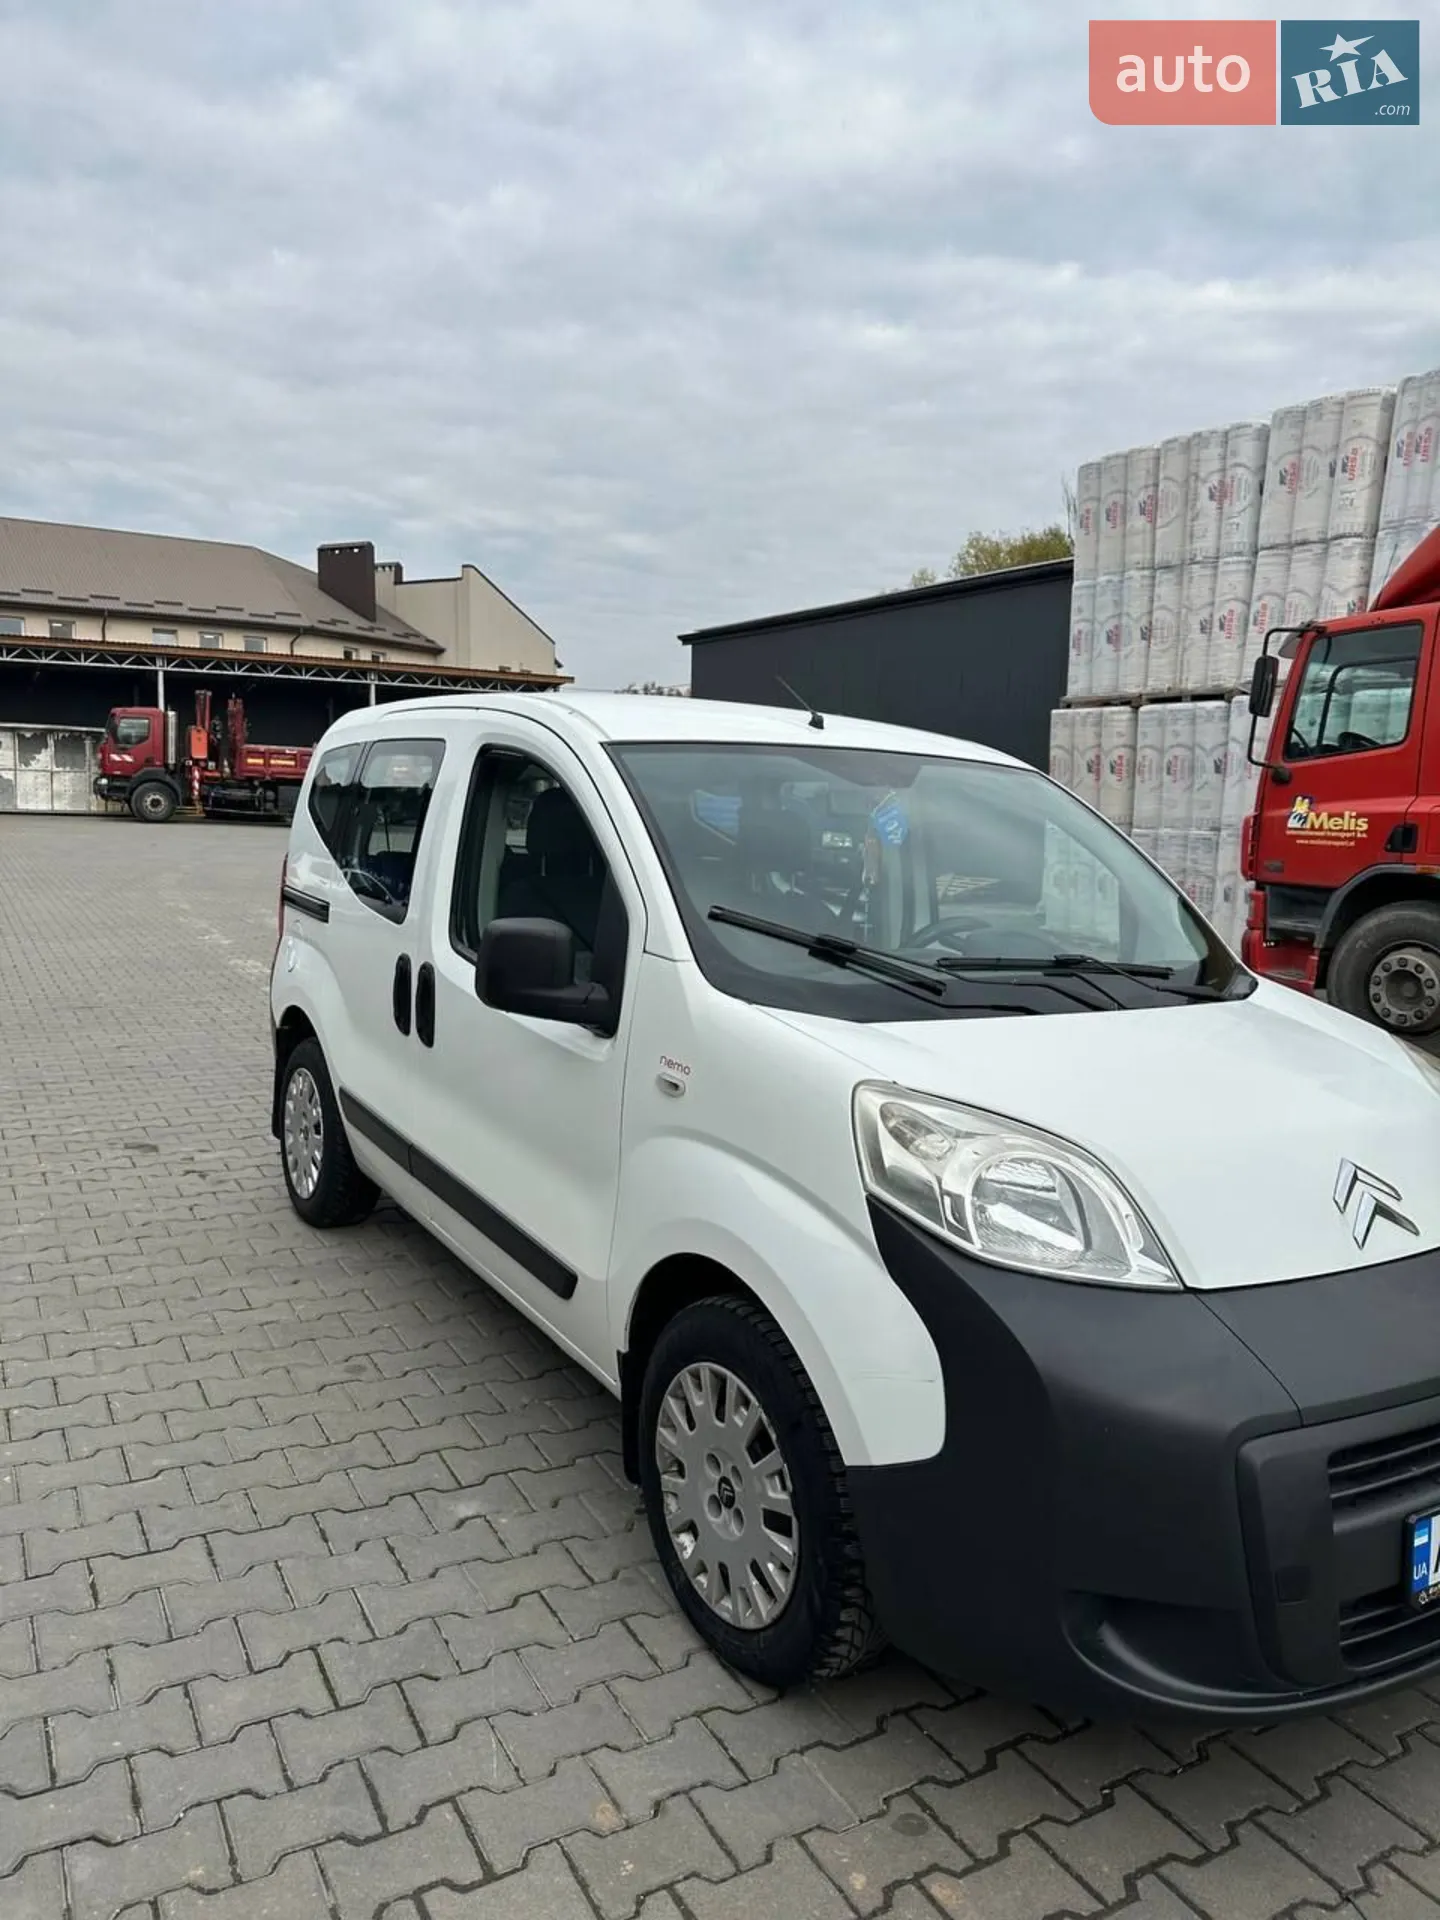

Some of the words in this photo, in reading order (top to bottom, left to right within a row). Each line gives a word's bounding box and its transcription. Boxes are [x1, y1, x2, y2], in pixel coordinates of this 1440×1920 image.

[1306, 810, 1369, 831] Melis
[660, 1055, 691, 1075] nemo
[1413, 1561, 1429, 1580] UA
